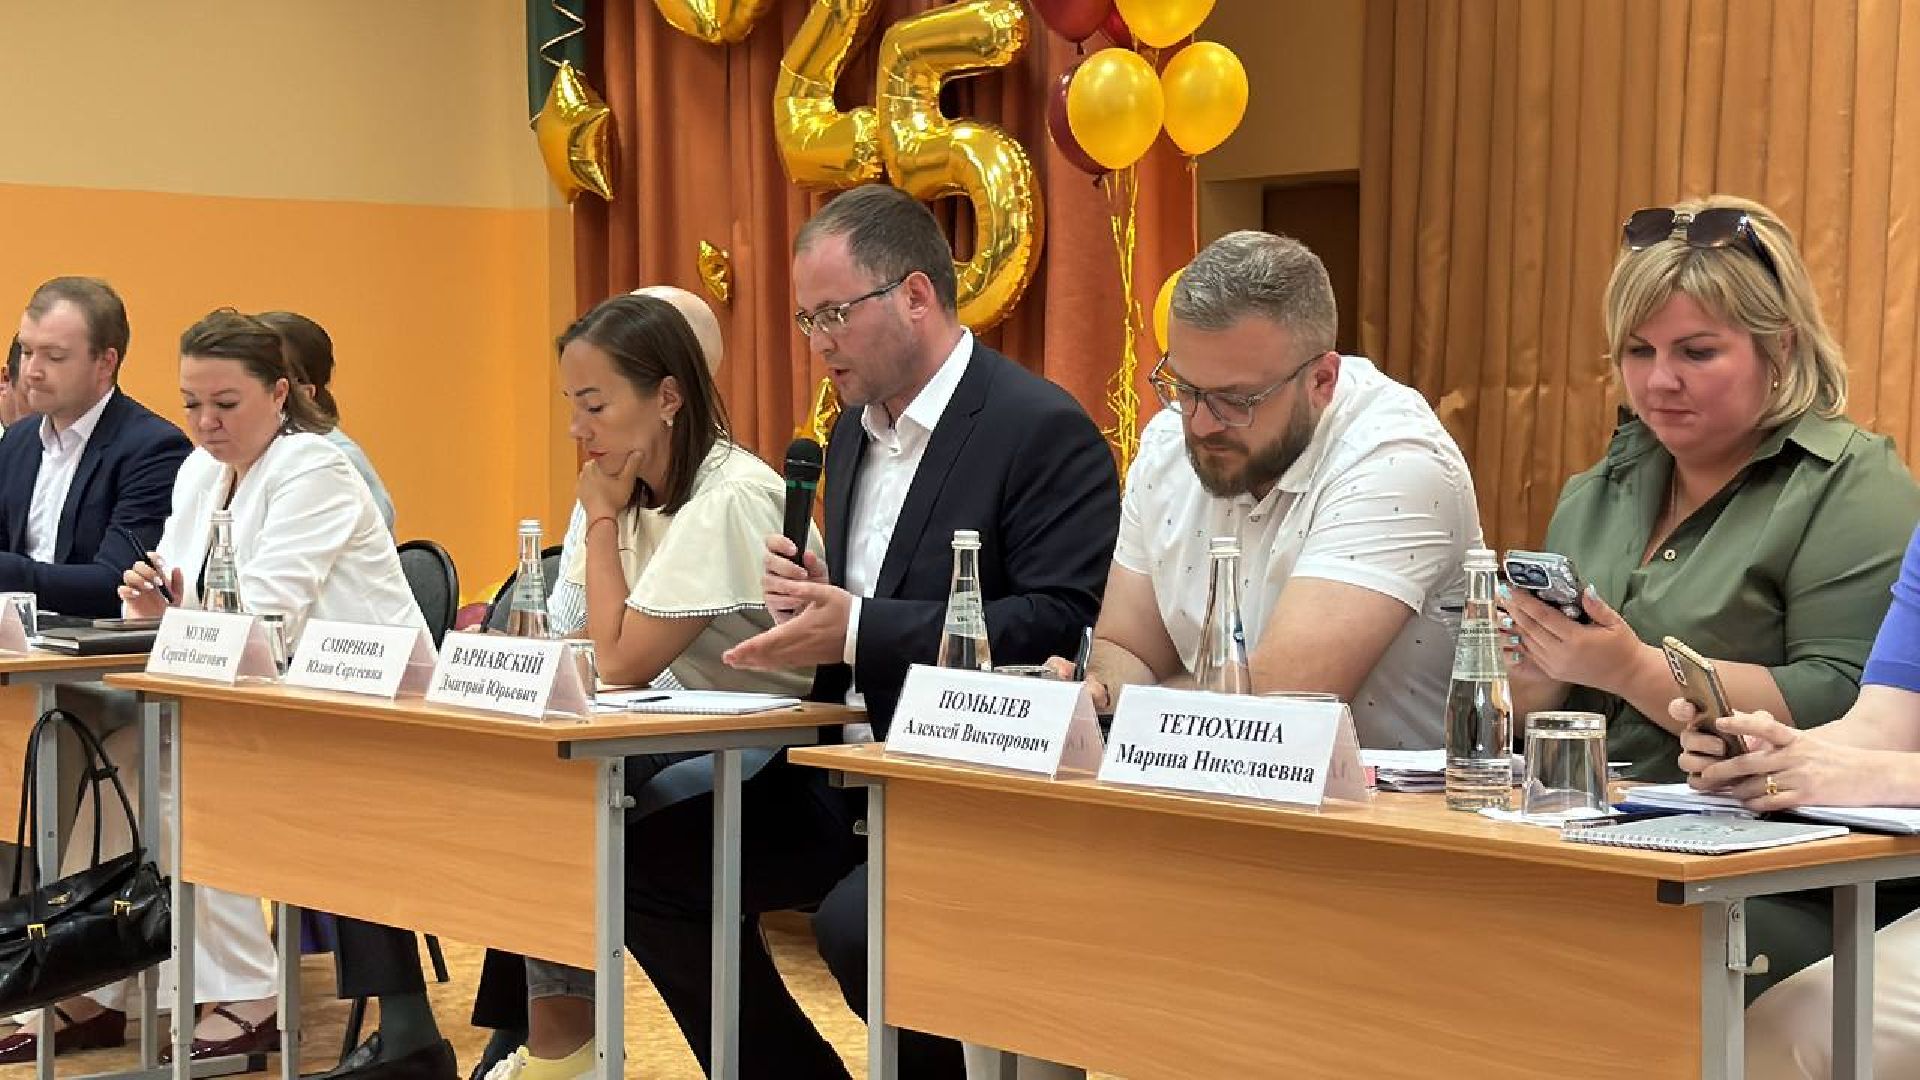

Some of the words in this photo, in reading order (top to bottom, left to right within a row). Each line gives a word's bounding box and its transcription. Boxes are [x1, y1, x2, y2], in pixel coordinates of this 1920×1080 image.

[320, 636, 385, 658] СМИРНОВА
[451, 647, 545, 675] ВАРНАВСКИЙ
[335, 661, 383, 680] Сергеевна
[438, 673, 486, 697] Дмитрий
[485, 679, 538, 703] Юрьевич
[938, 690, 1031, 718] ПОМЫЛЕВ
[903, 717, 960, 740] Алексей
[961, 723, 1050, 753] Викторович
[1159, 713, 1283, 744] ТЕТЮХИНА
[1115, 743, 1189, 771] Марина
[1193, 750, 1315, 784] Николаевна
